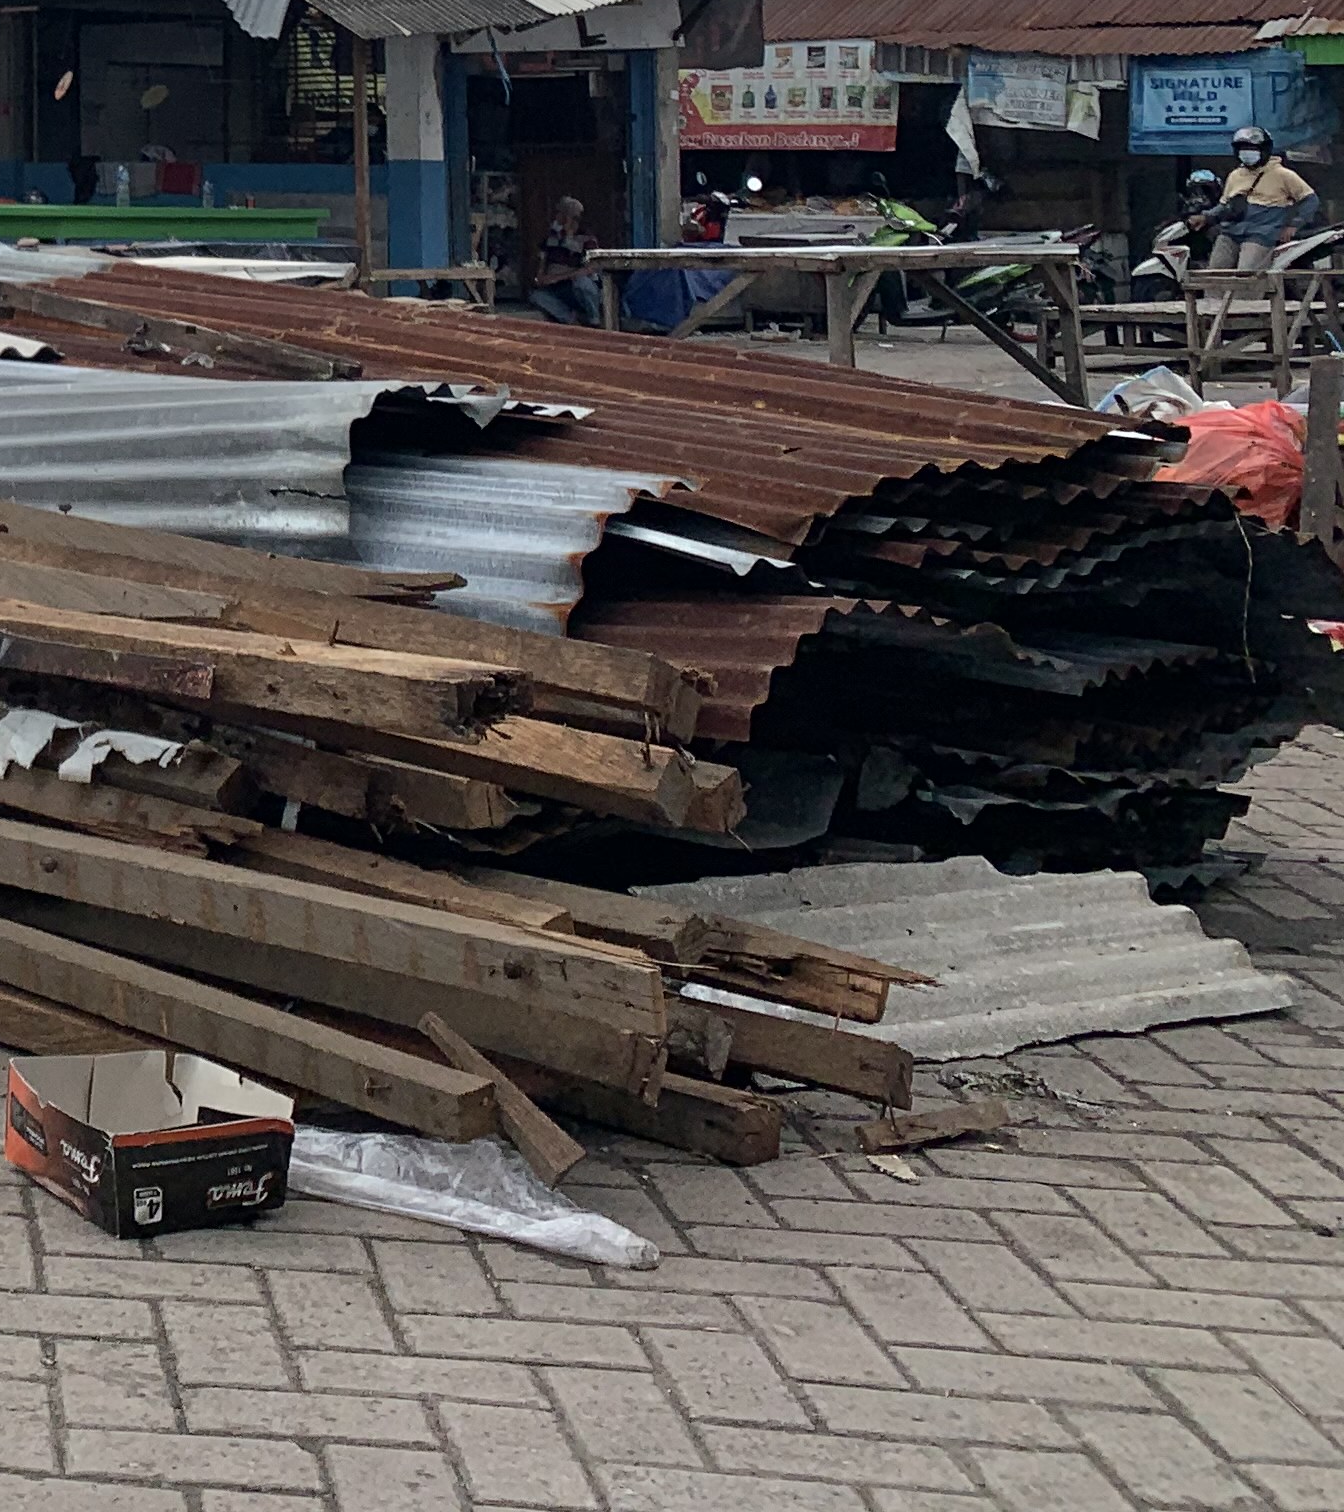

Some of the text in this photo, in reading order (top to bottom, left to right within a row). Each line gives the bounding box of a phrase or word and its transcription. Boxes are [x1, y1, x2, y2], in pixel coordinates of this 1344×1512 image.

[1150, 76, 1243, 89] SIGNATURE
[703, 132, 772, 147] Rasakan
[206, 1170, 274, 1207] Fema
[147, 1199, 160, 1219] 4
